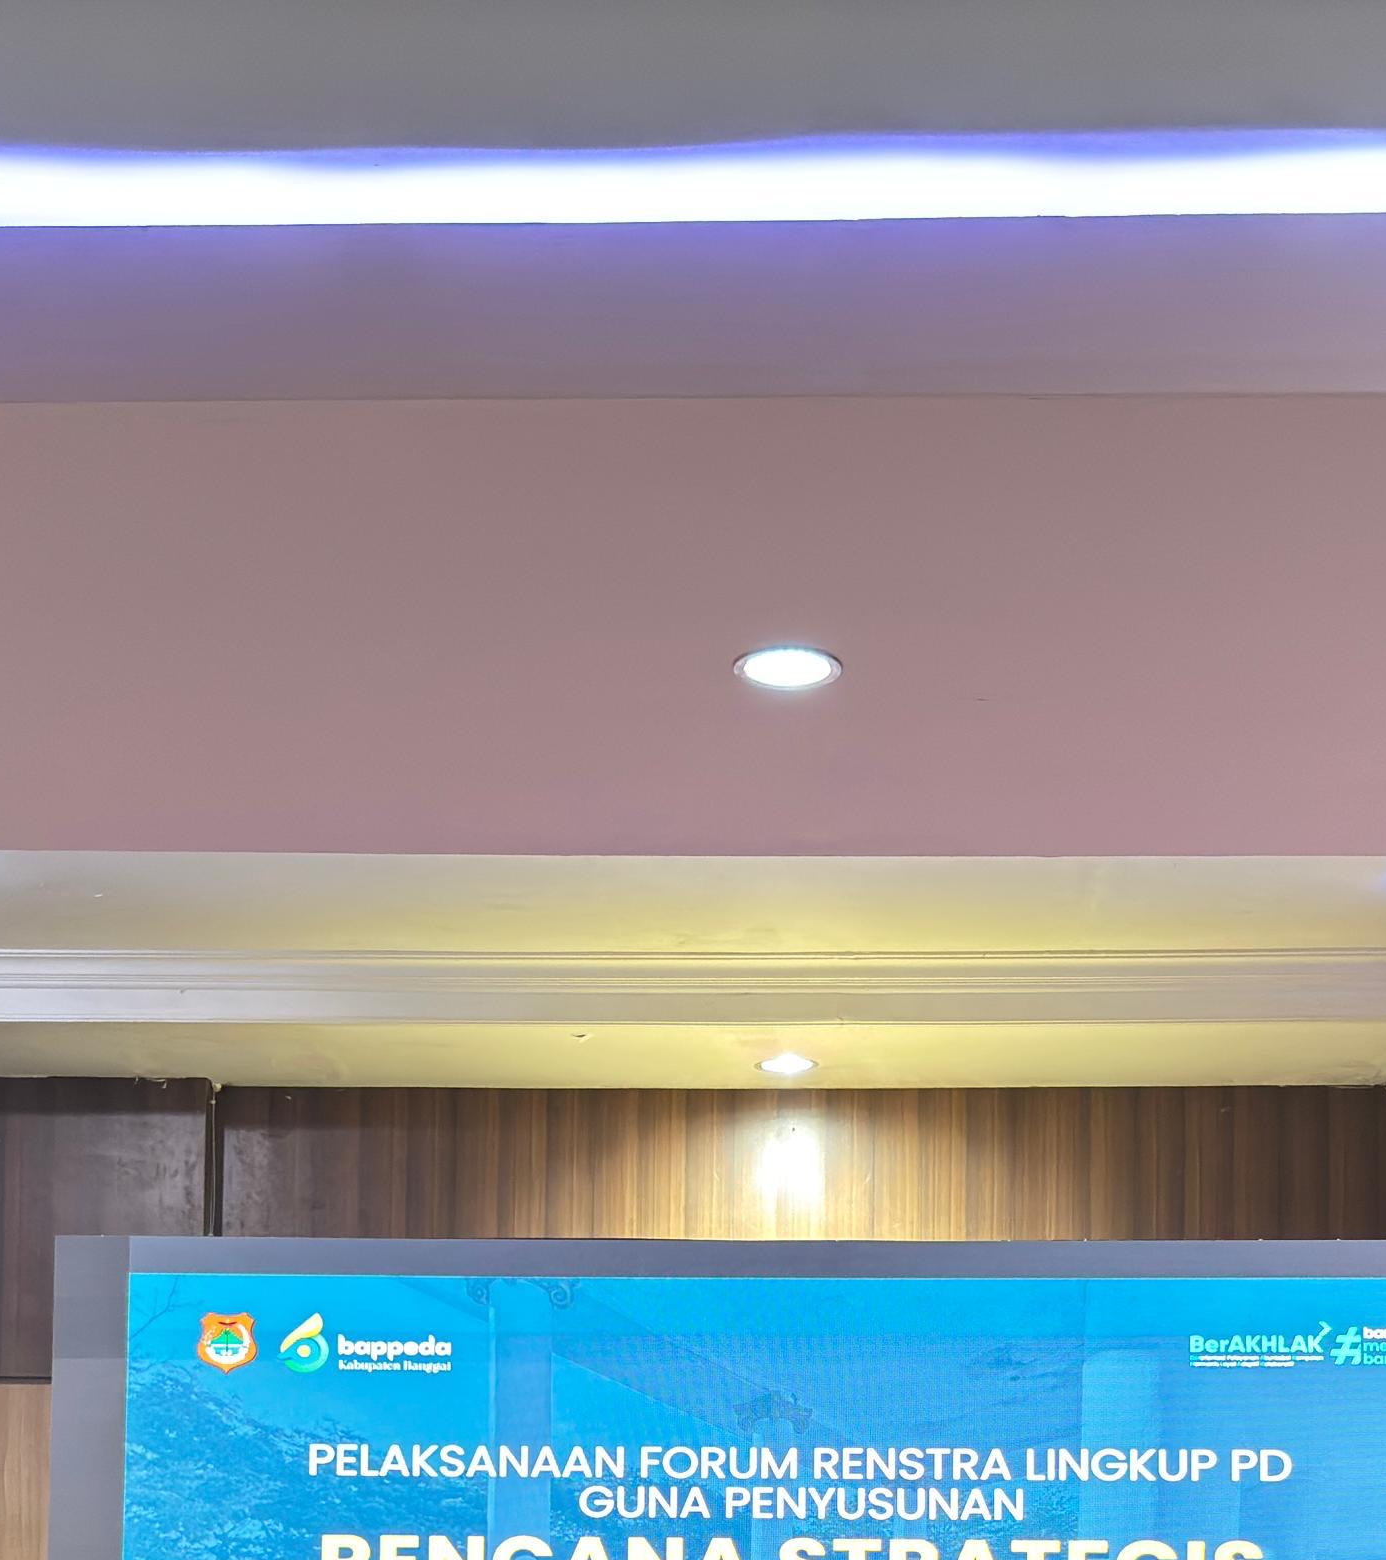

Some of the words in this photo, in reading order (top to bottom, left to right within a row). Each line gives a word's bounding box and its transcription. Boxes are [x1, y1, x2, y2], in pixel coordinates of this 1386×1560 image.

[337, 1333, 452, 1362] bappeda
[1189, 1329, 1329, 1353] BerAKHLAK
[308, 1443, 625, 1480] PELAKSANAAN
[640, 1446, 799, 1480] FORUM
[812, 1446, 1013, 1481] RENSTRA
[1025, 1447, 1219, 1482] LINGKUP
[1230, 1448, 1294, 1483] PD
[578, 1485, 711, 1520] GUNA
[724, 1486, 1025, 1522] PENYUSUNAN
